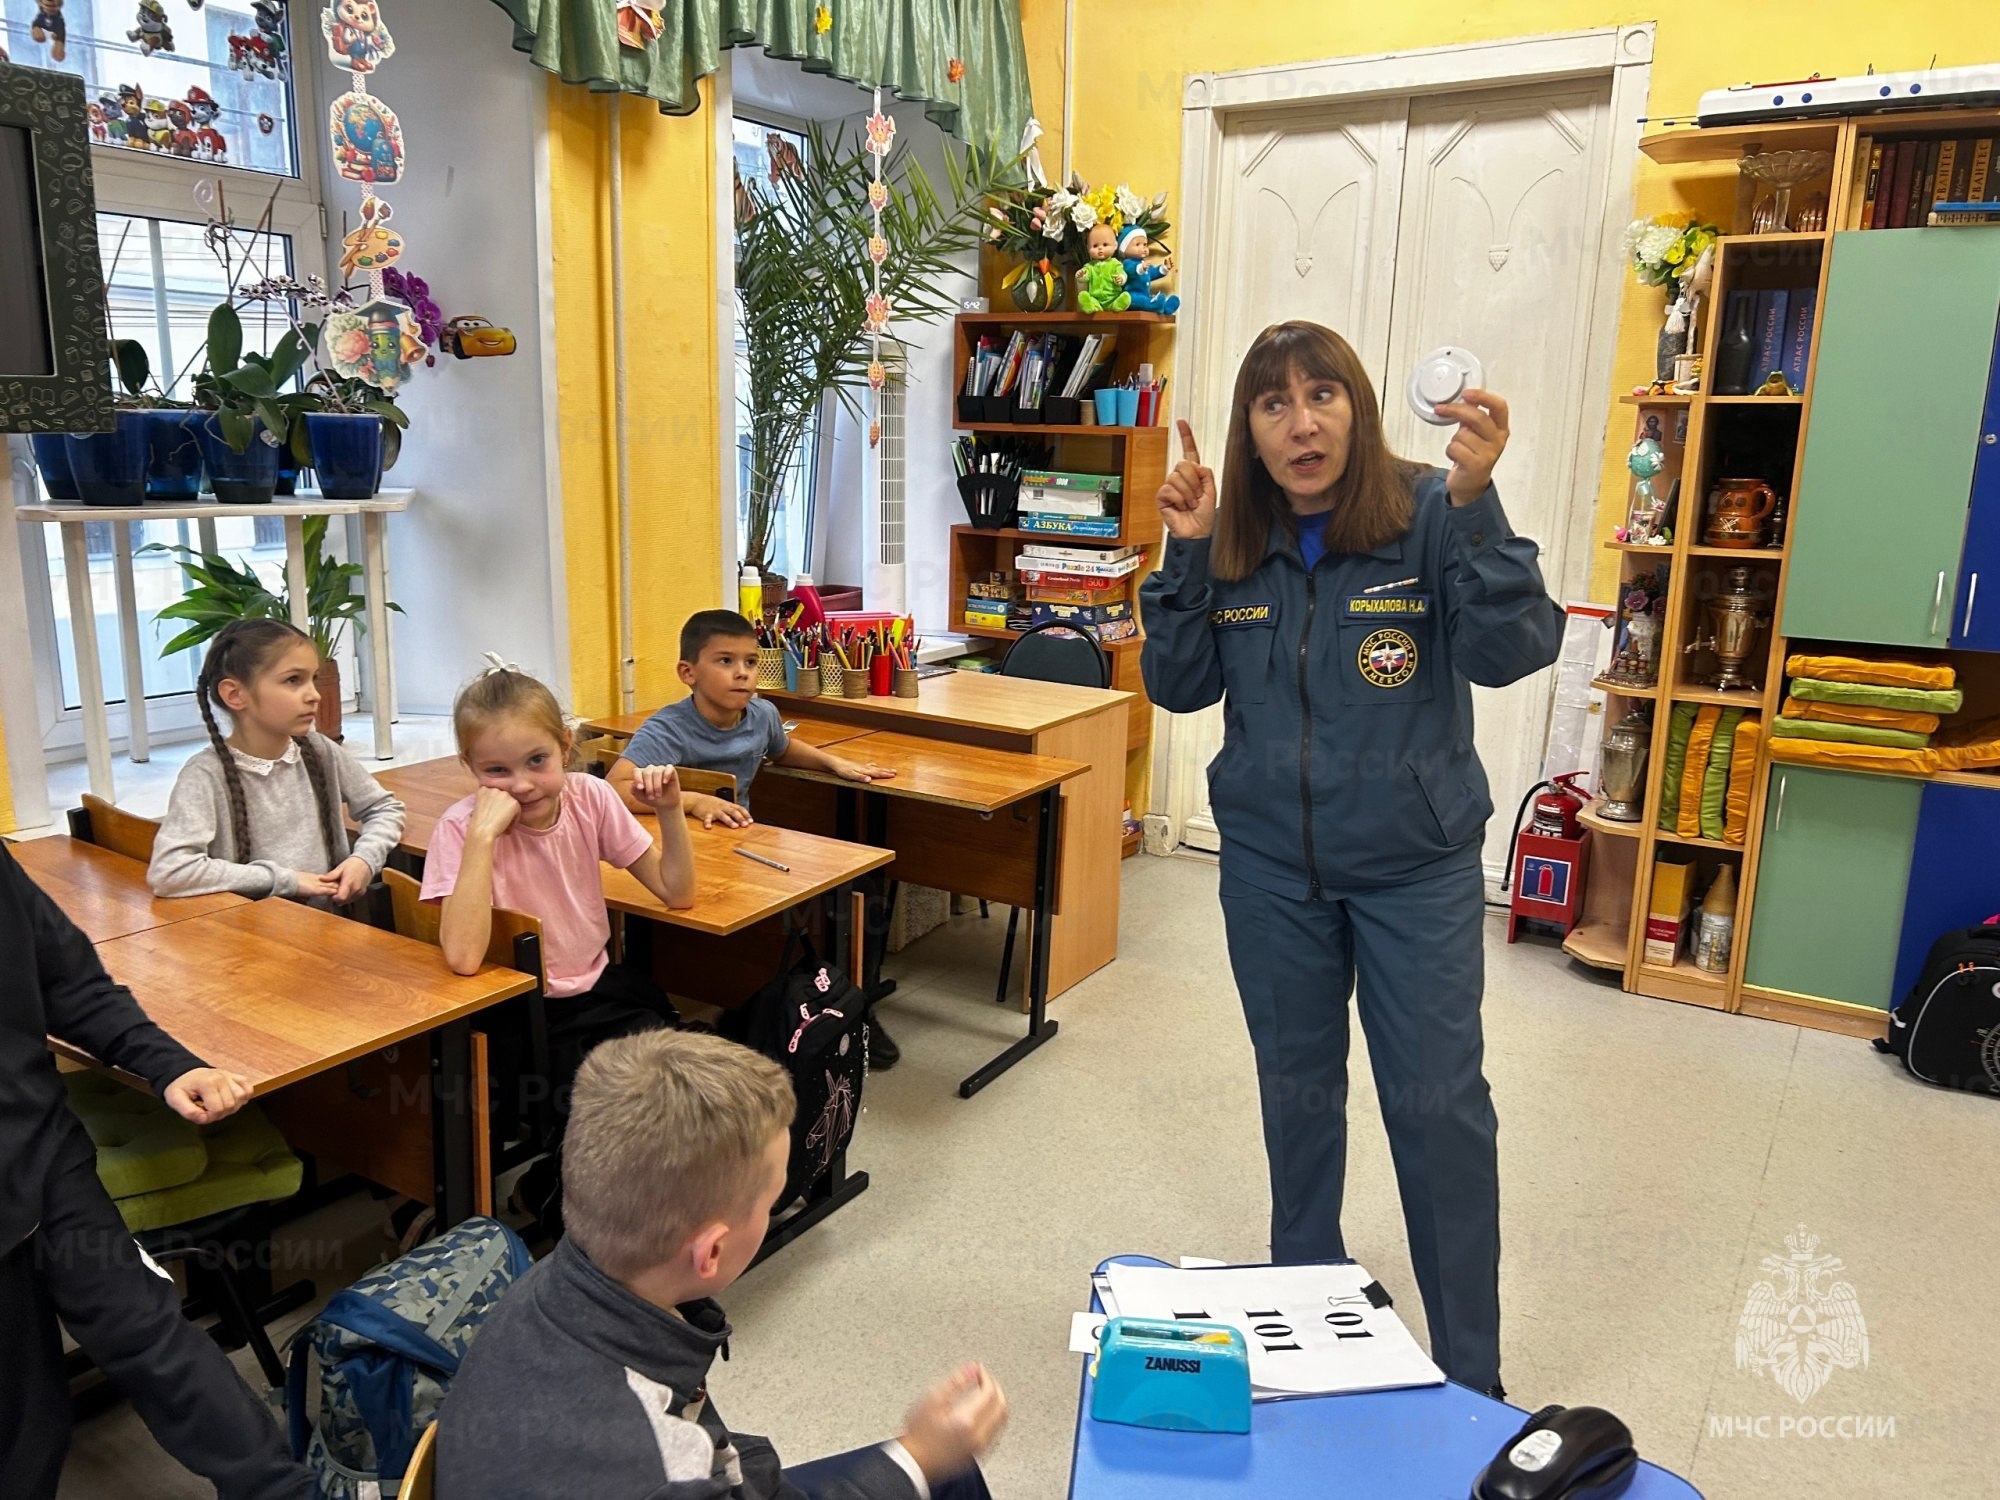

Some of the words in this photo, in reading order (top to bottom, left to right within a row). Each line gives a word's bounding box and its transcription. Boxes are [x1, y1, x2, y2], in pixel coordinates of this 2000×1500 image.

[1765, 307, 1777, 343] РОССИИ
[1796, 306, 1809, 343] РОССИИ
[1761, 344, 1773, 373] АТЛАС
[1792, 344, 1805, 373] АТЛАС
[1033, 520, 1073, 531] АЗБУКА
[1087, 578, 1105, 588] 500
[1224, 605, 1269, 623] РОССИИ
[1349, 599, 1407, 613] КОРЫХАЛОВА
[1362, 637, 1378, 656] МЧС
[1377, 631, 1412, 652] РОССИИ
[1363, 661, 1414, 684] EMERCOM
[1244, 1307, 1305, 1356] 101
[1324, 1311, 1375, 1341] 01
[1145, 1355, 1202, 1374] ZANUSSI
